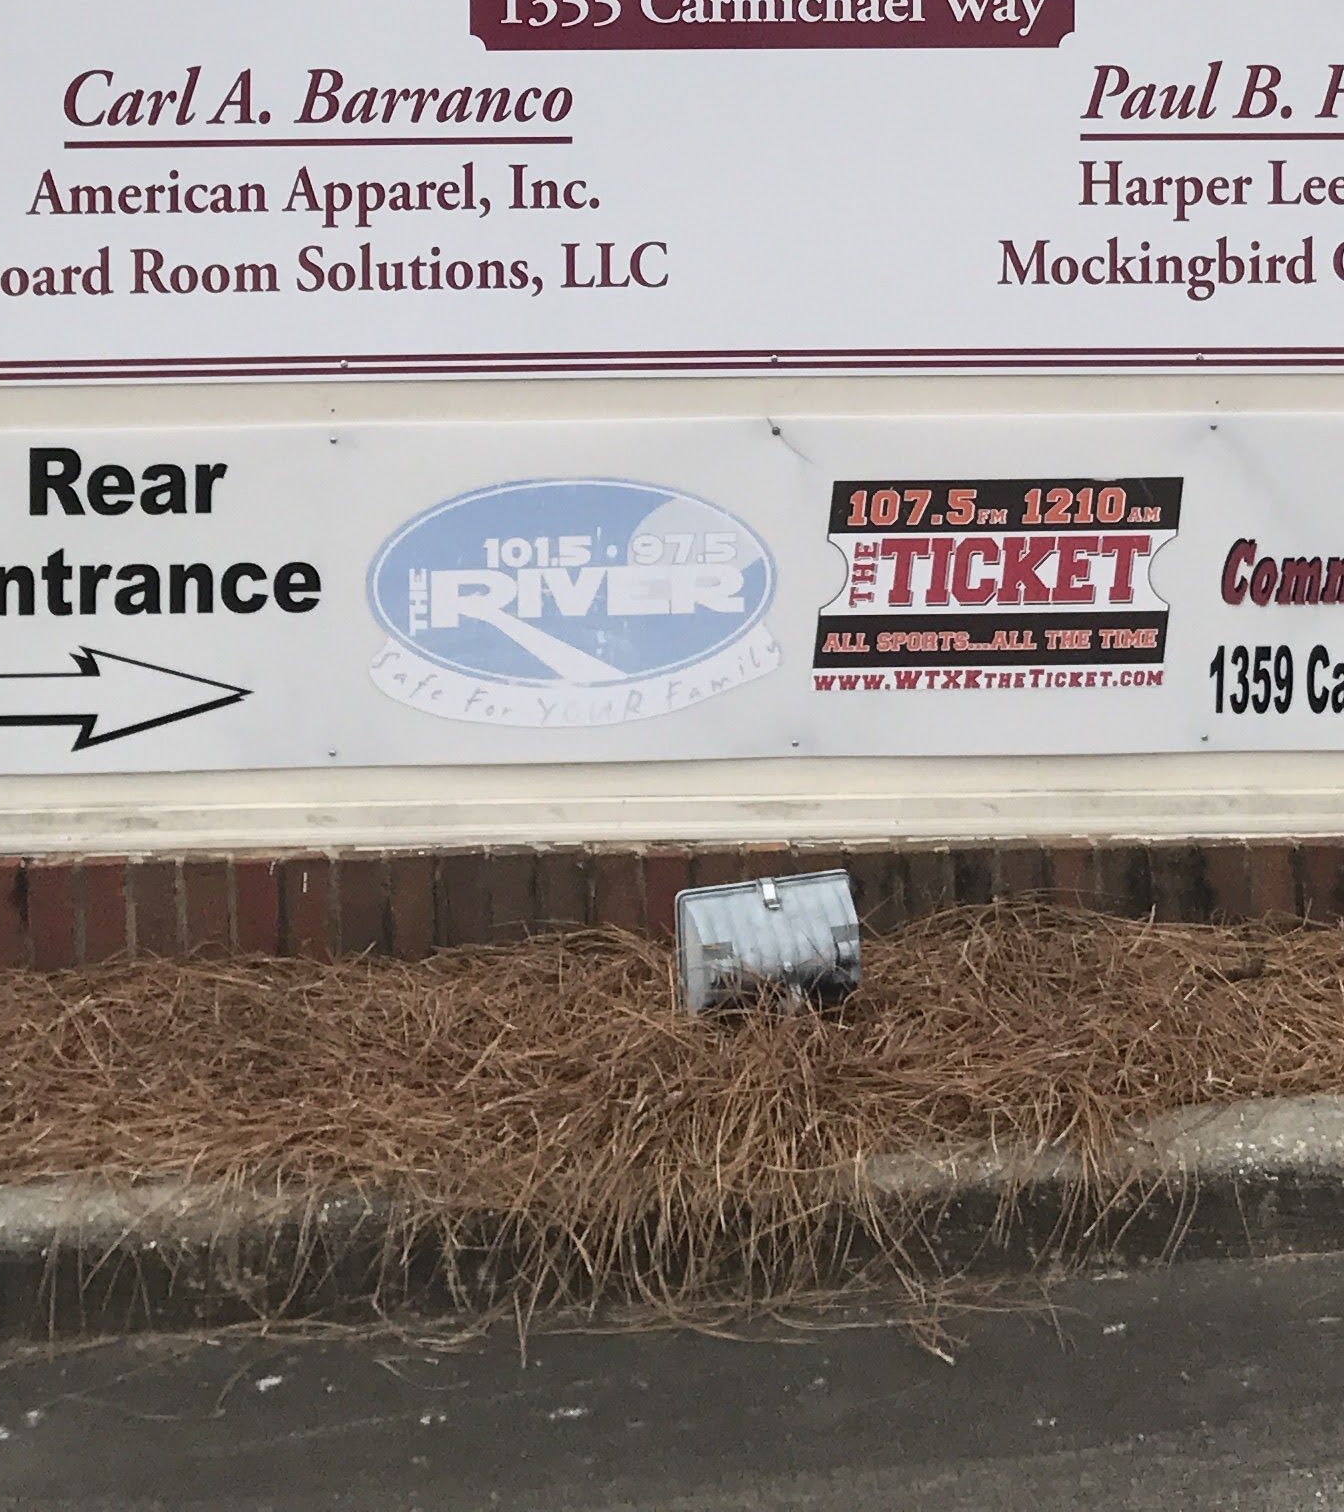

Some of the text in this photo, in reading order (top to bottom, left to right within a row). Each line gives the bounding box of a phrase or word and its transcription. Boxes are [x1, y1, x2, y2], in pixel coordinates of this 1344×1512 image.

[63, 65, 573, 127] Carl A. Barranco
[1079, 60, 1223, 120] Paul
[1231, 64, 1293, 120] B.
[25, 161, 600, 229] American Apparel, Inc.
[1078, 160, 1253, 222] Harper
[129, 248, 281, 295] Room
[296, 242, 544, 297] Solutions,
[560, 241, 669, 289] LLC
[997, 235, 1317, 302] Mockingbird
[29, 447, 228, 516] Rear
[483, 530, 738, 568] 101.5 97.5
[848, 534, 1151, 608] THE TICKET
[408, 564, 745, 680] THE RIVER
[821, 632, 871, 653] ALL
[1044, 629, 1093, 650] THE
[1098, 628, 1159, 649] TIME
[1209, 644, 1294, 715] 1359
